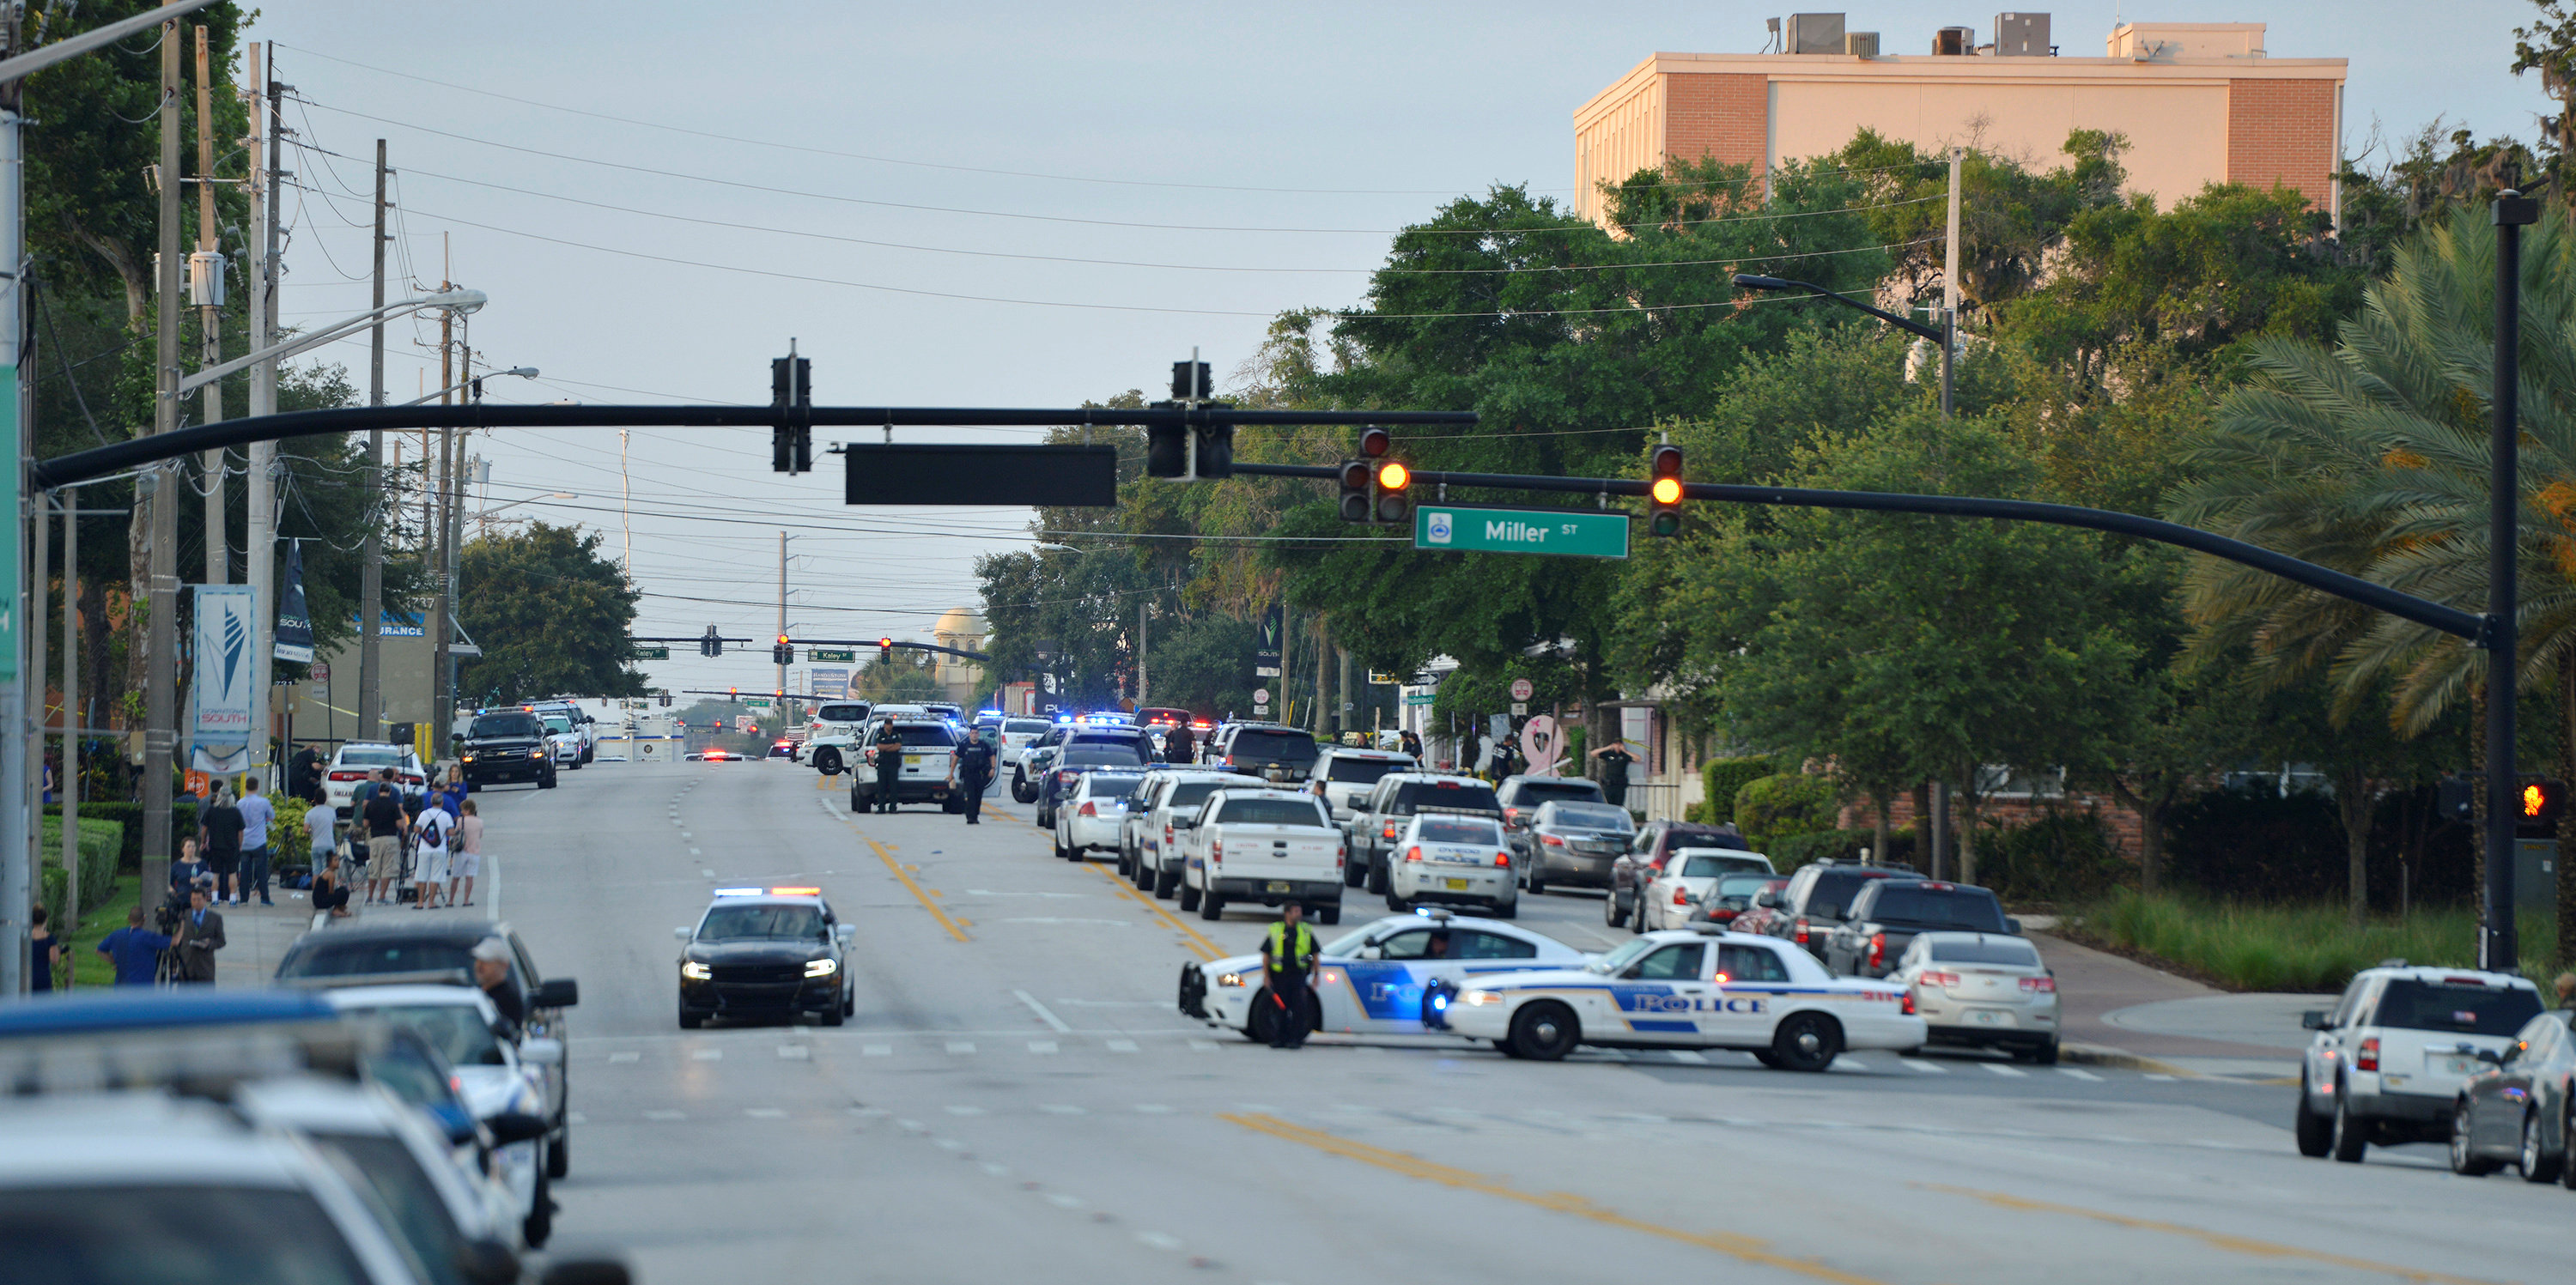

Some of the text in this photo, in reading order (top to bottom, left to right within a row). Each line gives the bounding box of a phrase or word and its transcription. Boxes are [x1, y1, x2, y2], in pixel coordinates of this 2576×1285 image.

[1485, 520, 1578, 542] Miller ST
[202, 713, 247, 724] SOUTH
[1634, 993, 1769, 1014] POLICE
